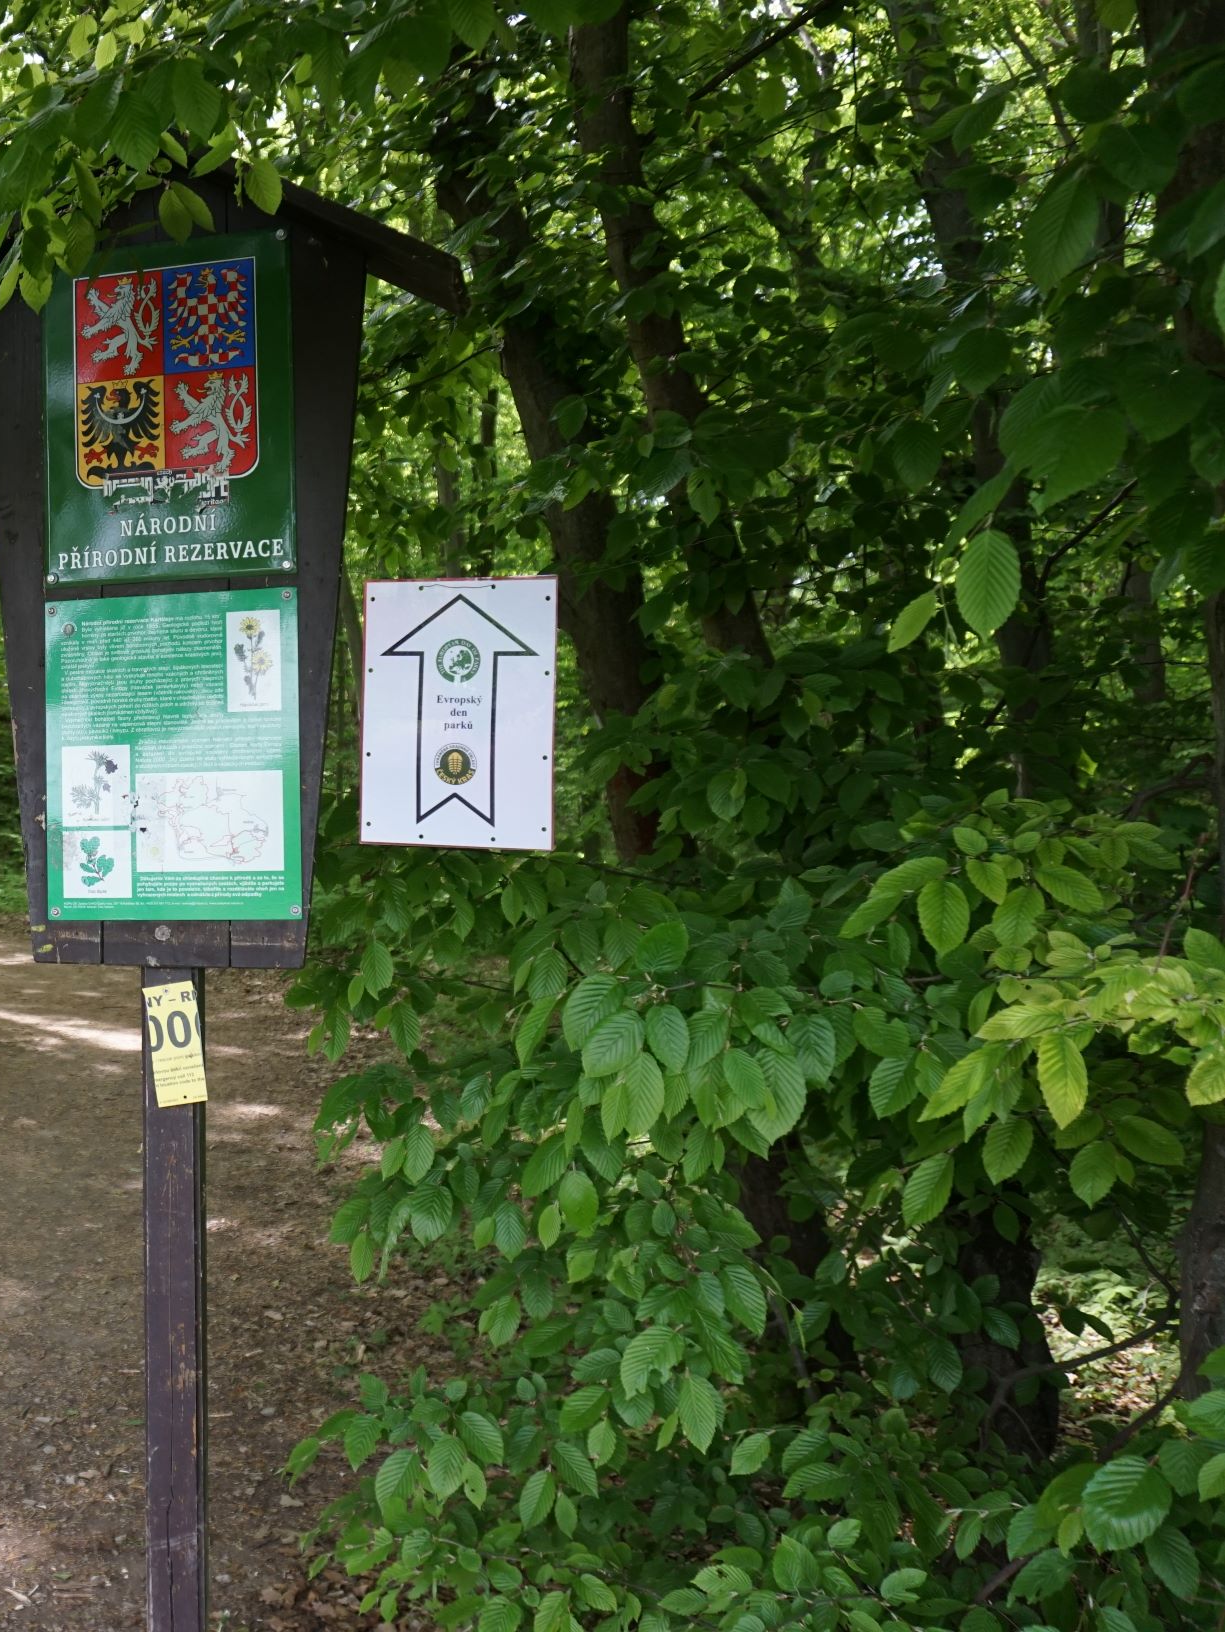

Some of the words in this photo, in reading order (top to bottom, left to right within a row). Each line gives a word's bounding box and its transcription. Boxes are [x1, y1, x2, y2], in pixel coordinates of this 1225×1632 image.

[120, 510, 216, 537] NÁRODNÍ
[58, 541, 157, 570] PŘÍRODNÍ
[164, 539, 284, 563] REZERVACE
[436, 694, 482, 706] Evropský
[450, 708, 467, 717] den
[444, 720, 473, 731] parků
